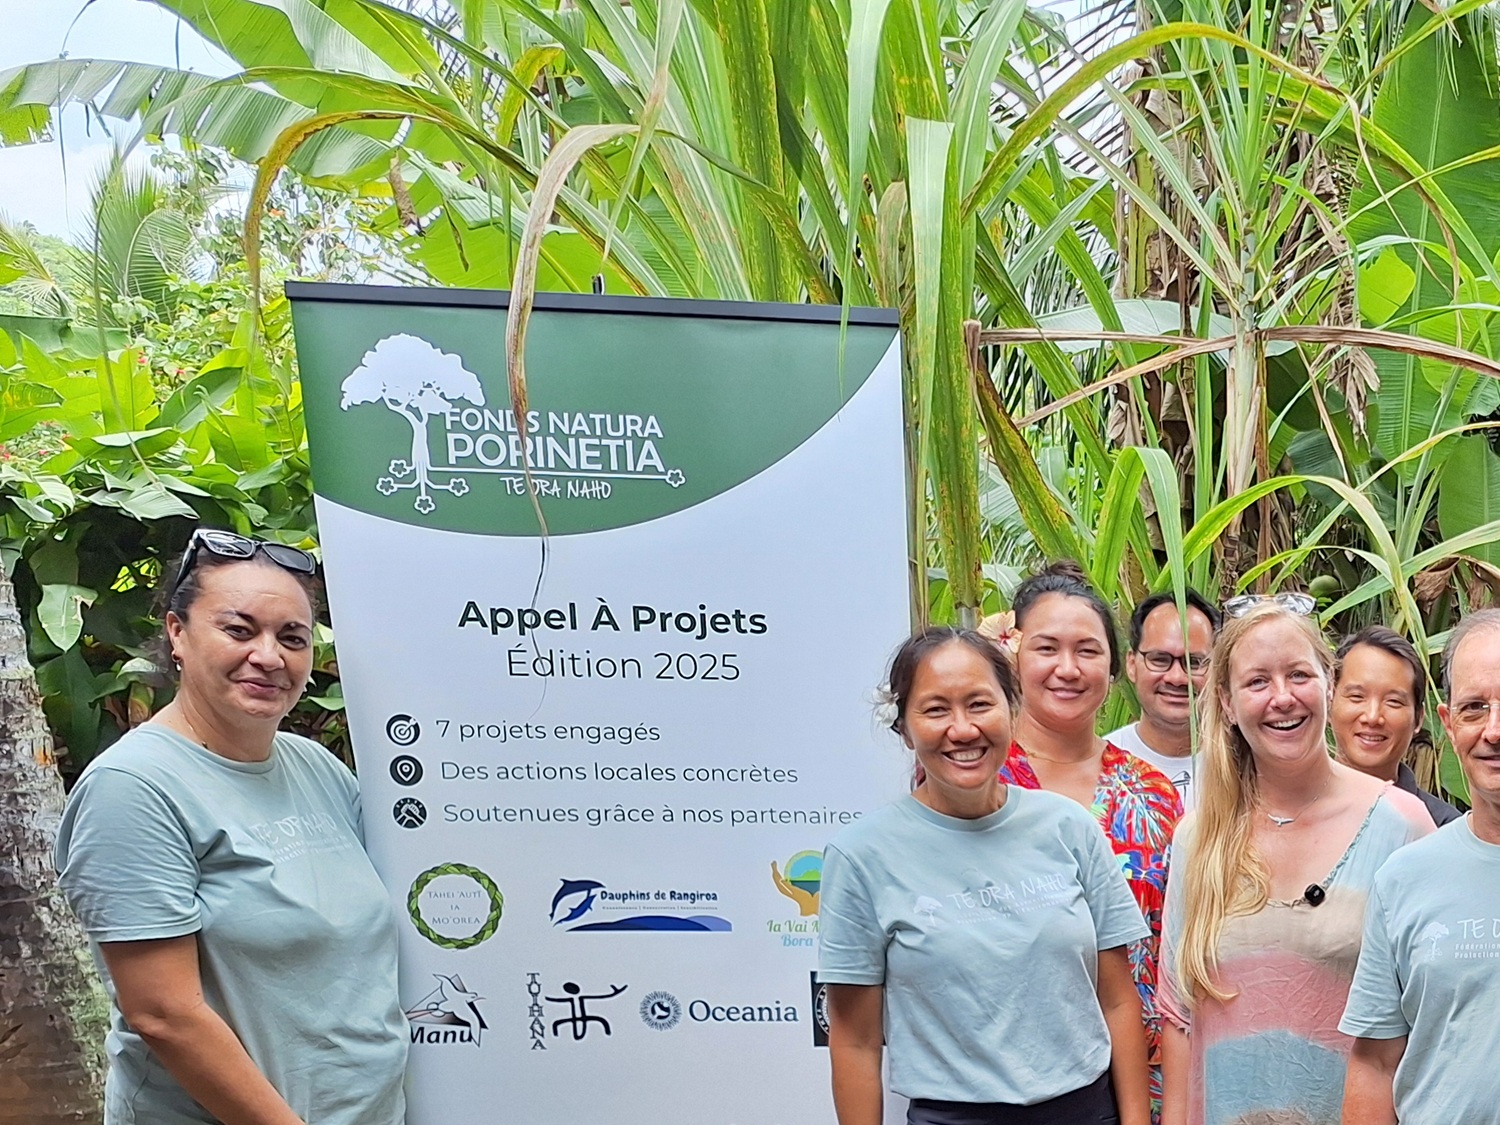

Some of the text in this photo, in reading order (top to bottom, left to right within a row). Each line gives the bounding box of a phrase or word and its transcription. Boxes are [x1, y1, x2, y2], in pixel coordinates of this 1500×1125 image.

[548, 411, 664, 438] NATURA
[446, 432, 666, 473] PORINETIA
[499, 476, 526, 496] TE
[567, 480, 612, 499] NAHO
[458, 596, 768, 640] Appel À Projets
[507, 642, 741, 680] Édition 2025
[435, 719, 661, 745] 7 projets engagés
[441, 761, 799, 783] Des actions locales concrètes
[443, 804, 580, 822] Soutenues
[586, 803, 655, 827] grâce
[662, 804, 675, 823] à
[683, 808, 724, 824] nos
[600, 890, 718, 904] Dauphins de Rangiroa
[946, 890, 976, 910] TE
[978, 883, 1016, 907] ORA
[1020, 873, 1068, 898] NAHO
[781, 934, 813, 947] Bora
[1457, 917, 1486, 940] TE
[688, 999, 799, 1022] Oceania
